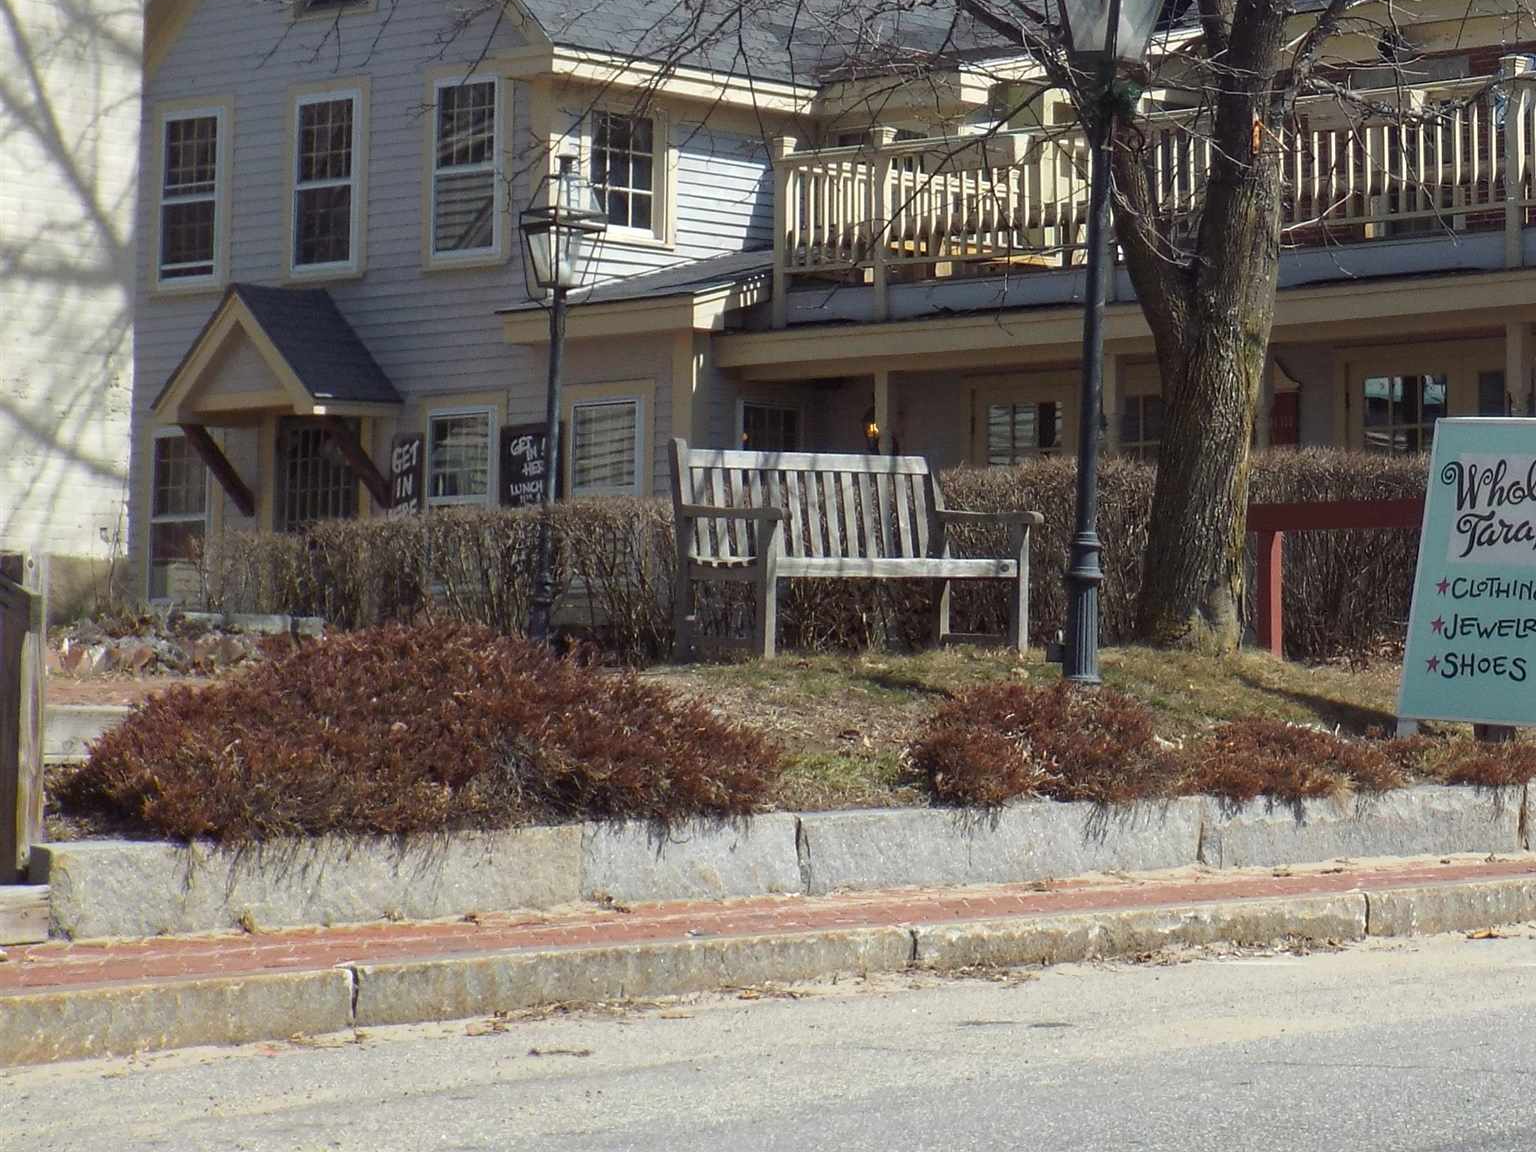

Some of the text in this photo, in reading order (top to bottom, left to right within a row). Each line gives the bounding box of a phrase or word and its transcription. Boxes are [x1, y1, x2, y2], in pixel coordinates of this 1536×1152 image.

[393, 440, 419, 473] GET
[510, 435, 533, 456] GET
[396, 474, 412, 498] IN
[1440, 654, 1527, 682] SHOES
